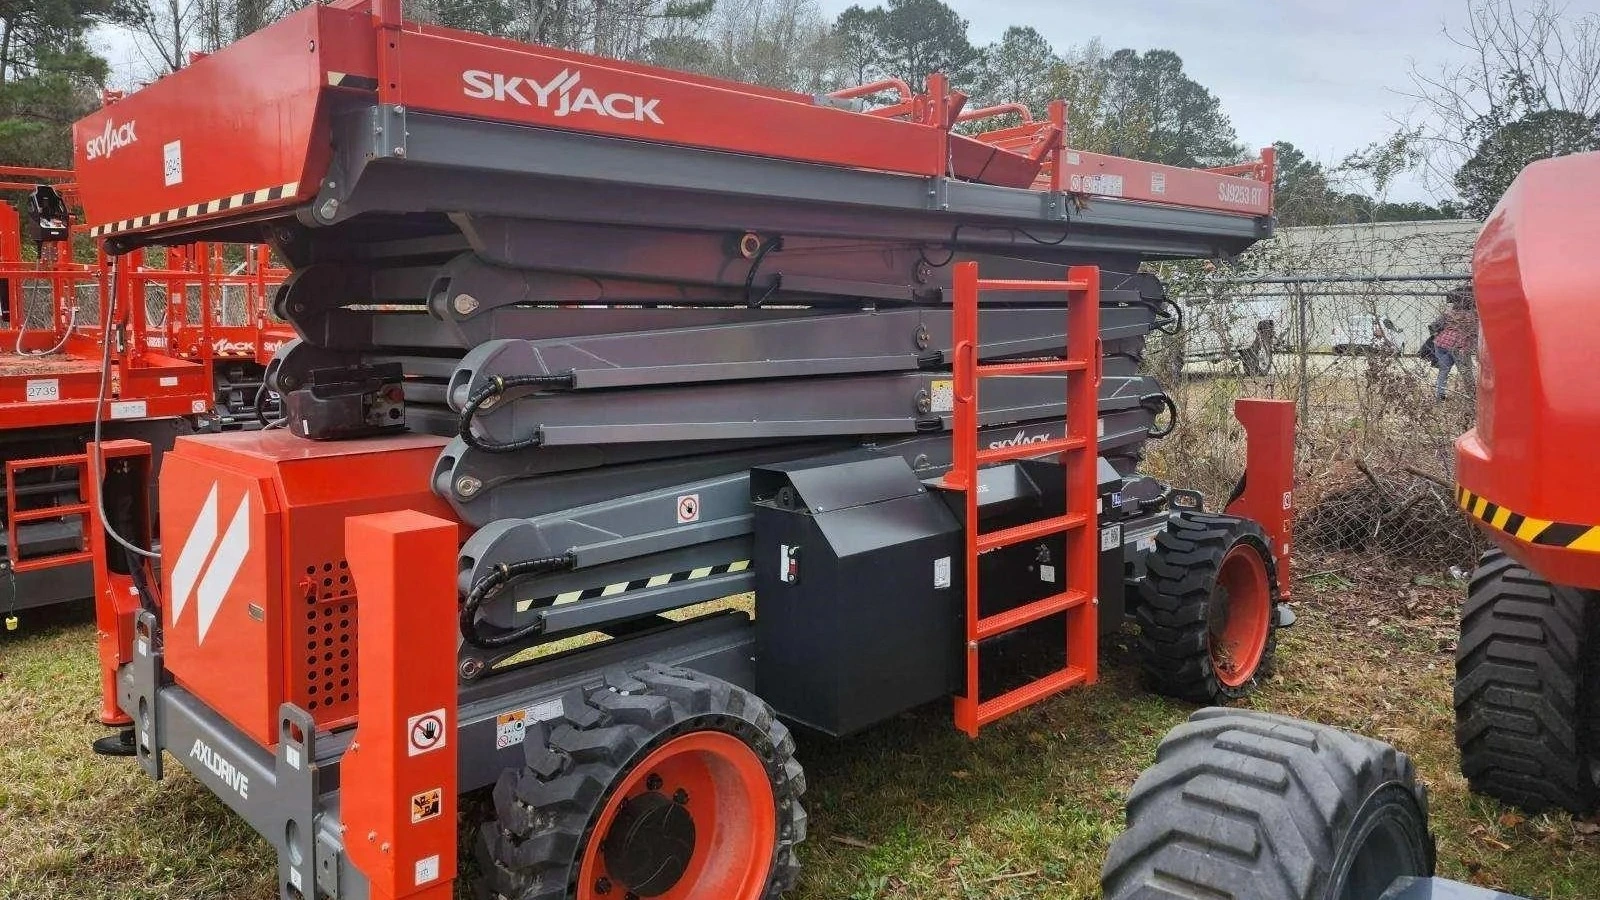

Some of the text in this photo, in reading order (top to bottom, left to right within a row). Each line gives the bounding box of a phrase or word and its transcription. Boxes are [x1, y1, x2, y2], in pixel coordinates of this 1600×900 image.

[462, 68, 664, 124] SKYJACK
[86, 118, 138, 160] SKYJACK
[1251, 187, 1263, 206] RT
[211, 339, 256, 351] YJACK
[28, 386, 57, 397] 2739
[190, 739, 249, 800] AXLDRIVE
